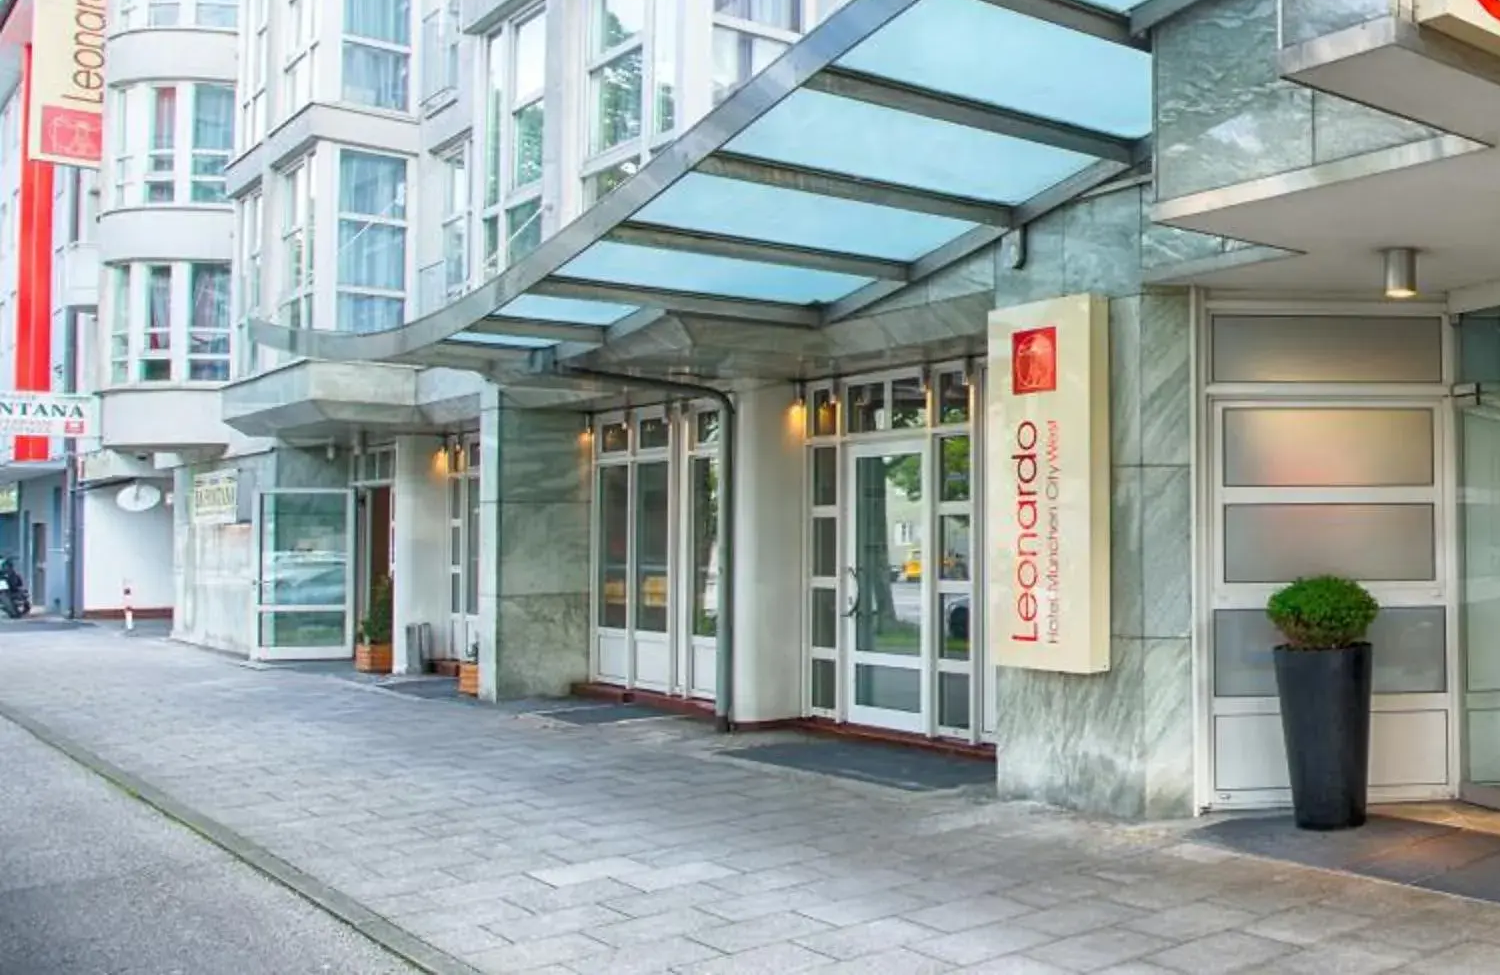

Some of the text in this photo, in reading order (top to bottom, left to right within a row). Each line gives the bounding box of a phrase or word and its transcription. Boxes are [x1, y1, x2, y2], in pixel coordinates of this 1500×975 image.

[1045, 465, 1061, 500] City
[1011, 421, 1038, 642] Leonardo
[1046, 597, 1059, 644] Hotel
